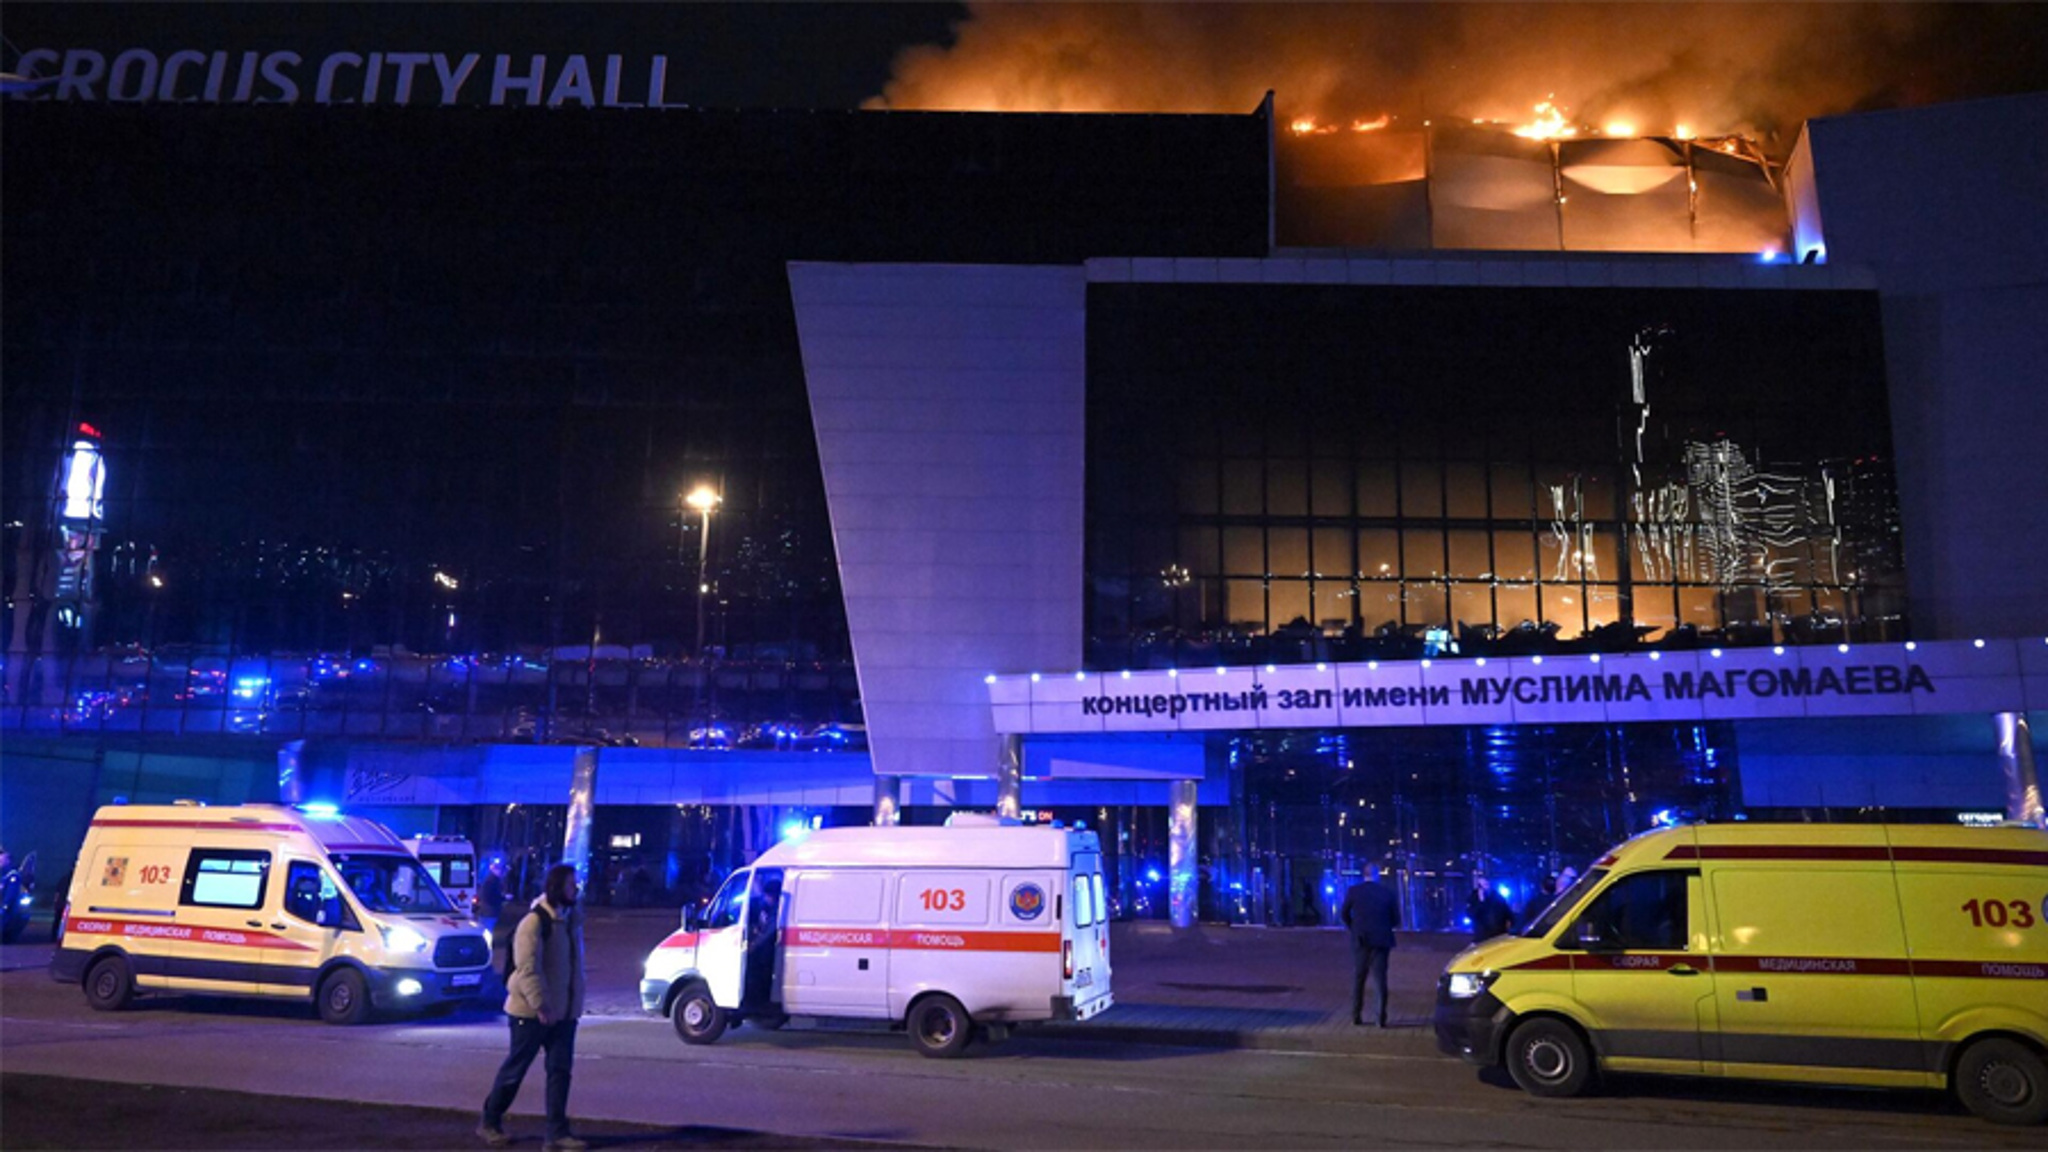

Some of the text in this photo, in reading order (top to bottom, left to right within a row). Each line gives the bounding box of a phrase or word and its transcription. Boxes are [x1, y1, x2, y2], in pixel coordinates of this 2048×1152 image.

[11, 48, 688, 108] CROCUS CITY HALL
[1082, 664, 1936, 719] концертный зал имени МУСЛИМА МАГОМАЕВА
[139, 865, 171, 884] 103
[920, 889, 966, 911] 103
[1961, 898, 2035, 929] 103
[77, 921, 247, 944] СКОРАЯ МЕДИЦИНСКАЯ ПОМОЩЬ
[798, 932, 965, 947] МЕДИЦИНСКАЯ ПОМОЩЬ
[1612, 956, 2046, 978] СКОРАЯ МЕДИЦИНСКАЯ ПОМОЩЬ
